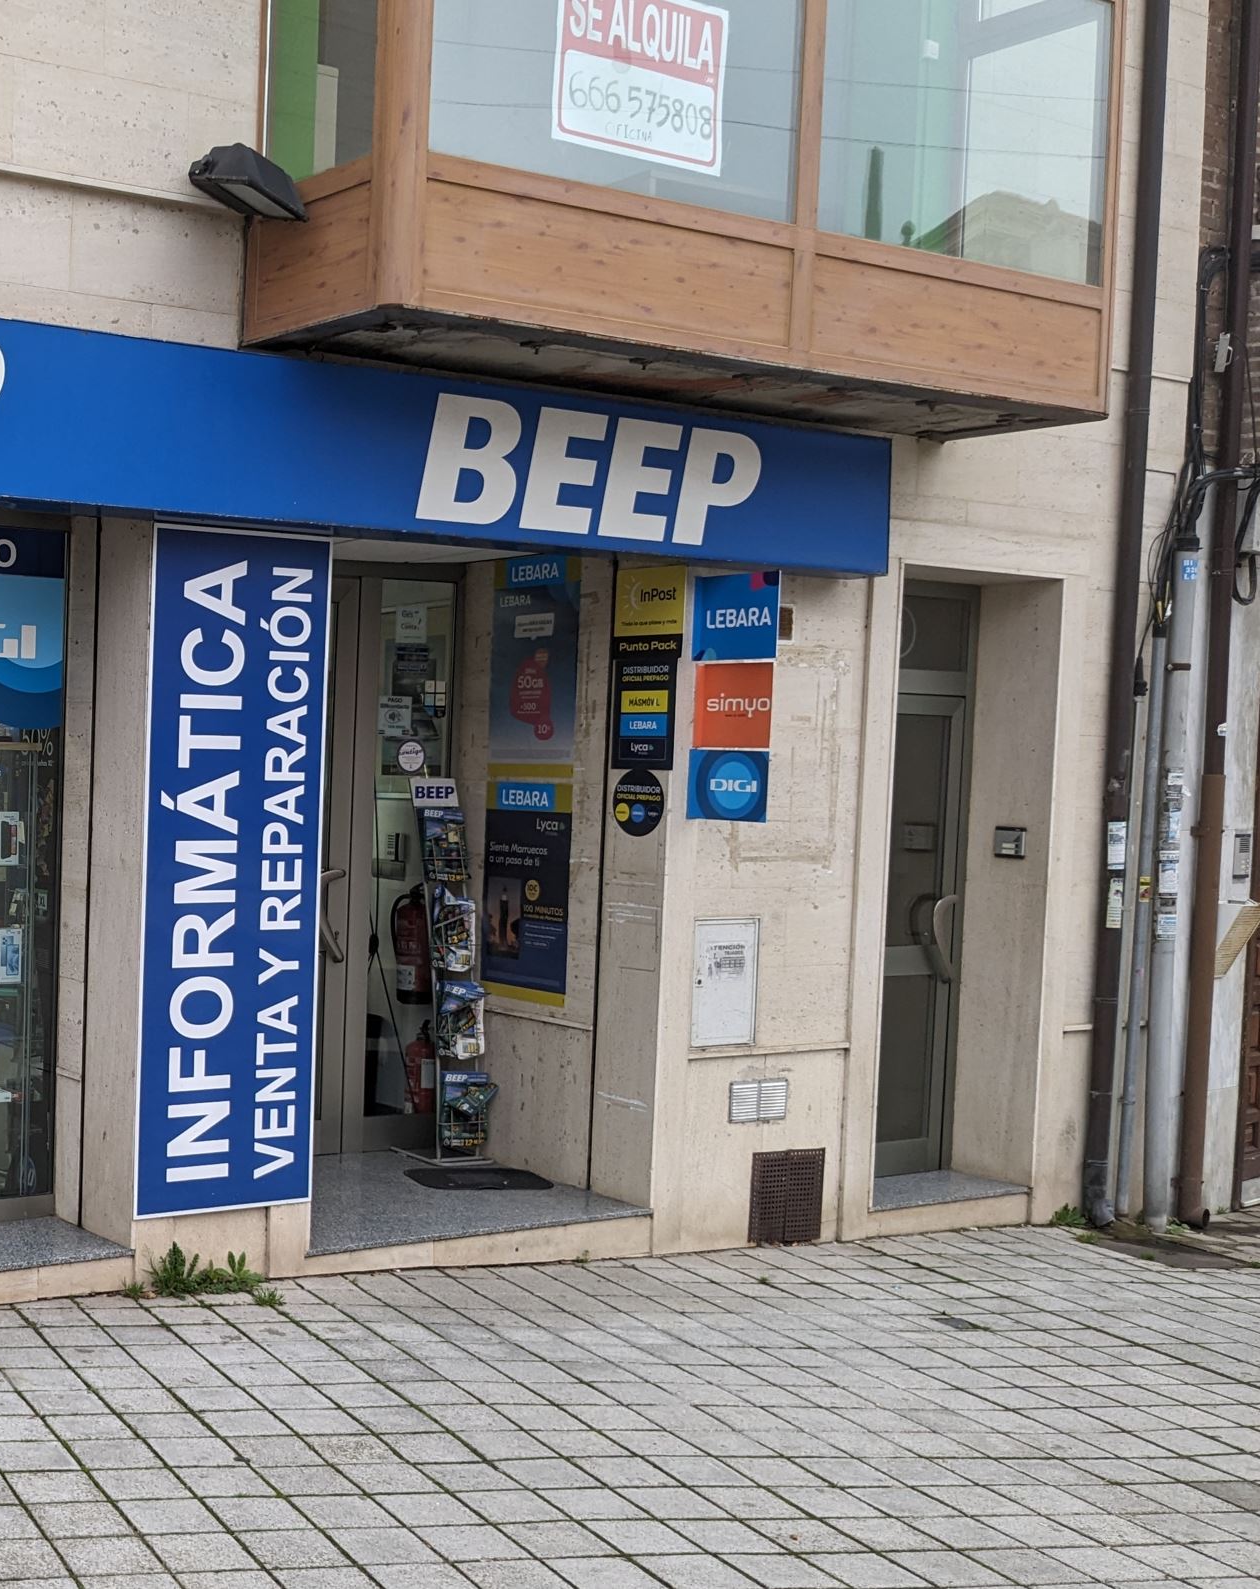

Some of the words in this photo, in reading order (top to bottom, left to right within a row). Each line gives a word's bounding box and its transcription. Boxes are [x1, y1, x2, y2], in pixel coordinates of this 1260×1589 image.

[569, 0, 603, 42] SE
[607, 0, 714, 74] ALQUILA
[569, 70, 622, 114] 666
[628, 85, 713, 141] 575808
[414, 392, 762, 546] BEEP
[511, 562, 559, 583] LEBARA
[499, 595, 532, 608] LEBARA
[640, 586, 677, 603] InPost
[706, 606, 772, 629] LEBARA
[619, 642, 649, 652] Punto
[650, 640, 677, 651] Pack
[622, 665, 669, 674] DISTRIBUIDOR
[706, 692, 771, 719] simyo
[629, 720, 657, 730] LEBARA
[259, 566, 314, 931] REPARACIÓN
[630, 742, 649, 753] Lyca
[414, 785, 455, 799] BEEP
[616, 784, 661, 794] DISTRIBUIDOR
[709, 778, 758, 793] DIGI
[501, 788, 549, 807] LEBARA
[424, 809, 444, 818] BEEP
[535, 817, 559, 832] Lyca
[489, 841, 510, 853] Siente
[505, 857, 522, 867] paso
[523, 856, 533, 866] de
[160, 559, 248, 1183] INFORMÁTICA
[534, 906, 564, 916] MINUTOS
[257, 947, 300, 985] Y
[444, 1073, 468, 1083] BEEP
[253, 994, 299, 1180] VENTA
